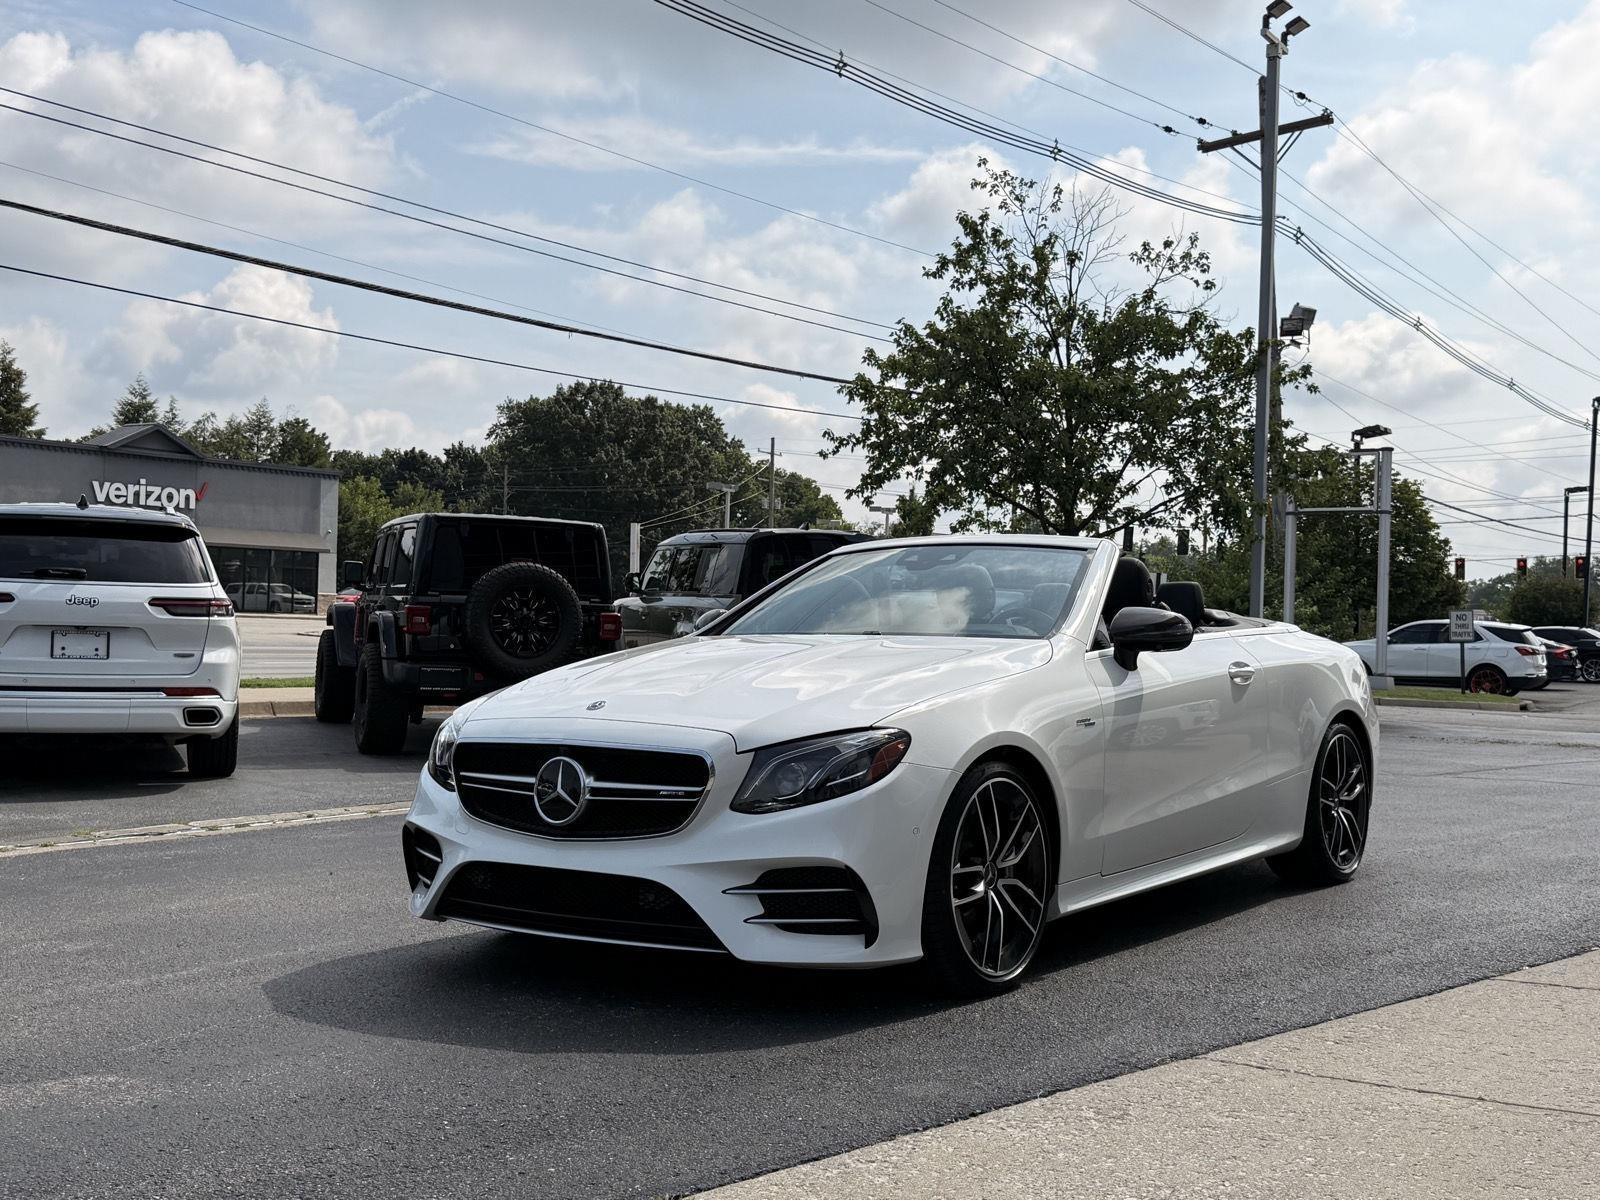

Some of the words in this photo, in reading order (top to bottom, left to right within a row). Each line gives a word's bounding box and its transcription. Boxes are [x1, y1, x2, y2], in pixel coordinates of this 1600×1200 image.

[92, 478, 196, 509] verizon
[65, 594, 99, 608] Jeep
[1456, 613, 1467, 621] NO
